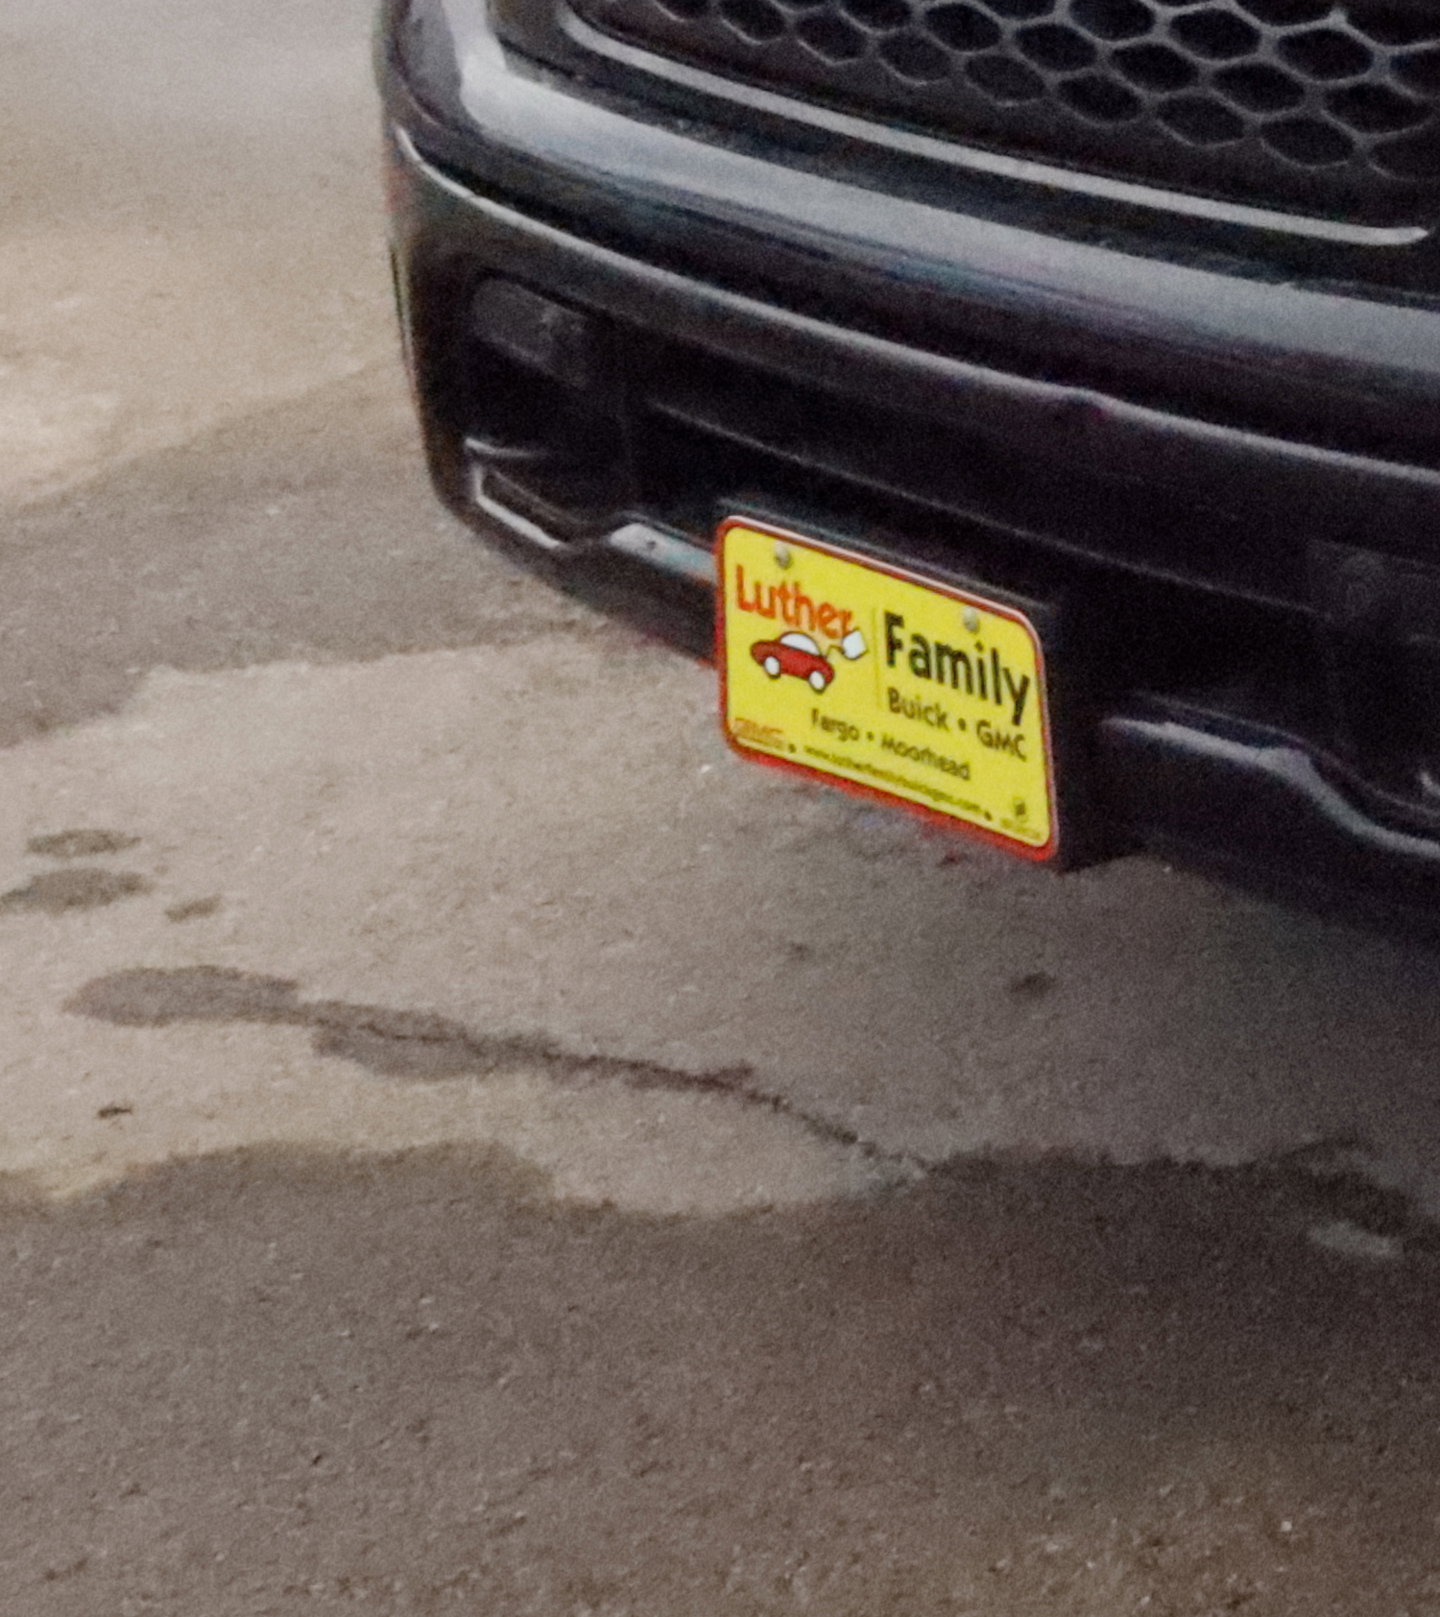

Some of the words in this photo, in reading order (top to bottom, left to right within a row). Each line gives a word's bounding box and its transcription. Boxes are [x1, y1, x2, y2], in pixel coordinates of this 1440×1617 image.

[736, 564, 853, 640] Luther
[884, 610, 1031, 726] Family
[811, 708, 860, 742] Fargo
[880, 733, 972, 781] Moorhead
[887, 687, 950, 733] Buick
[976, 719, 1027, 762] GMC
